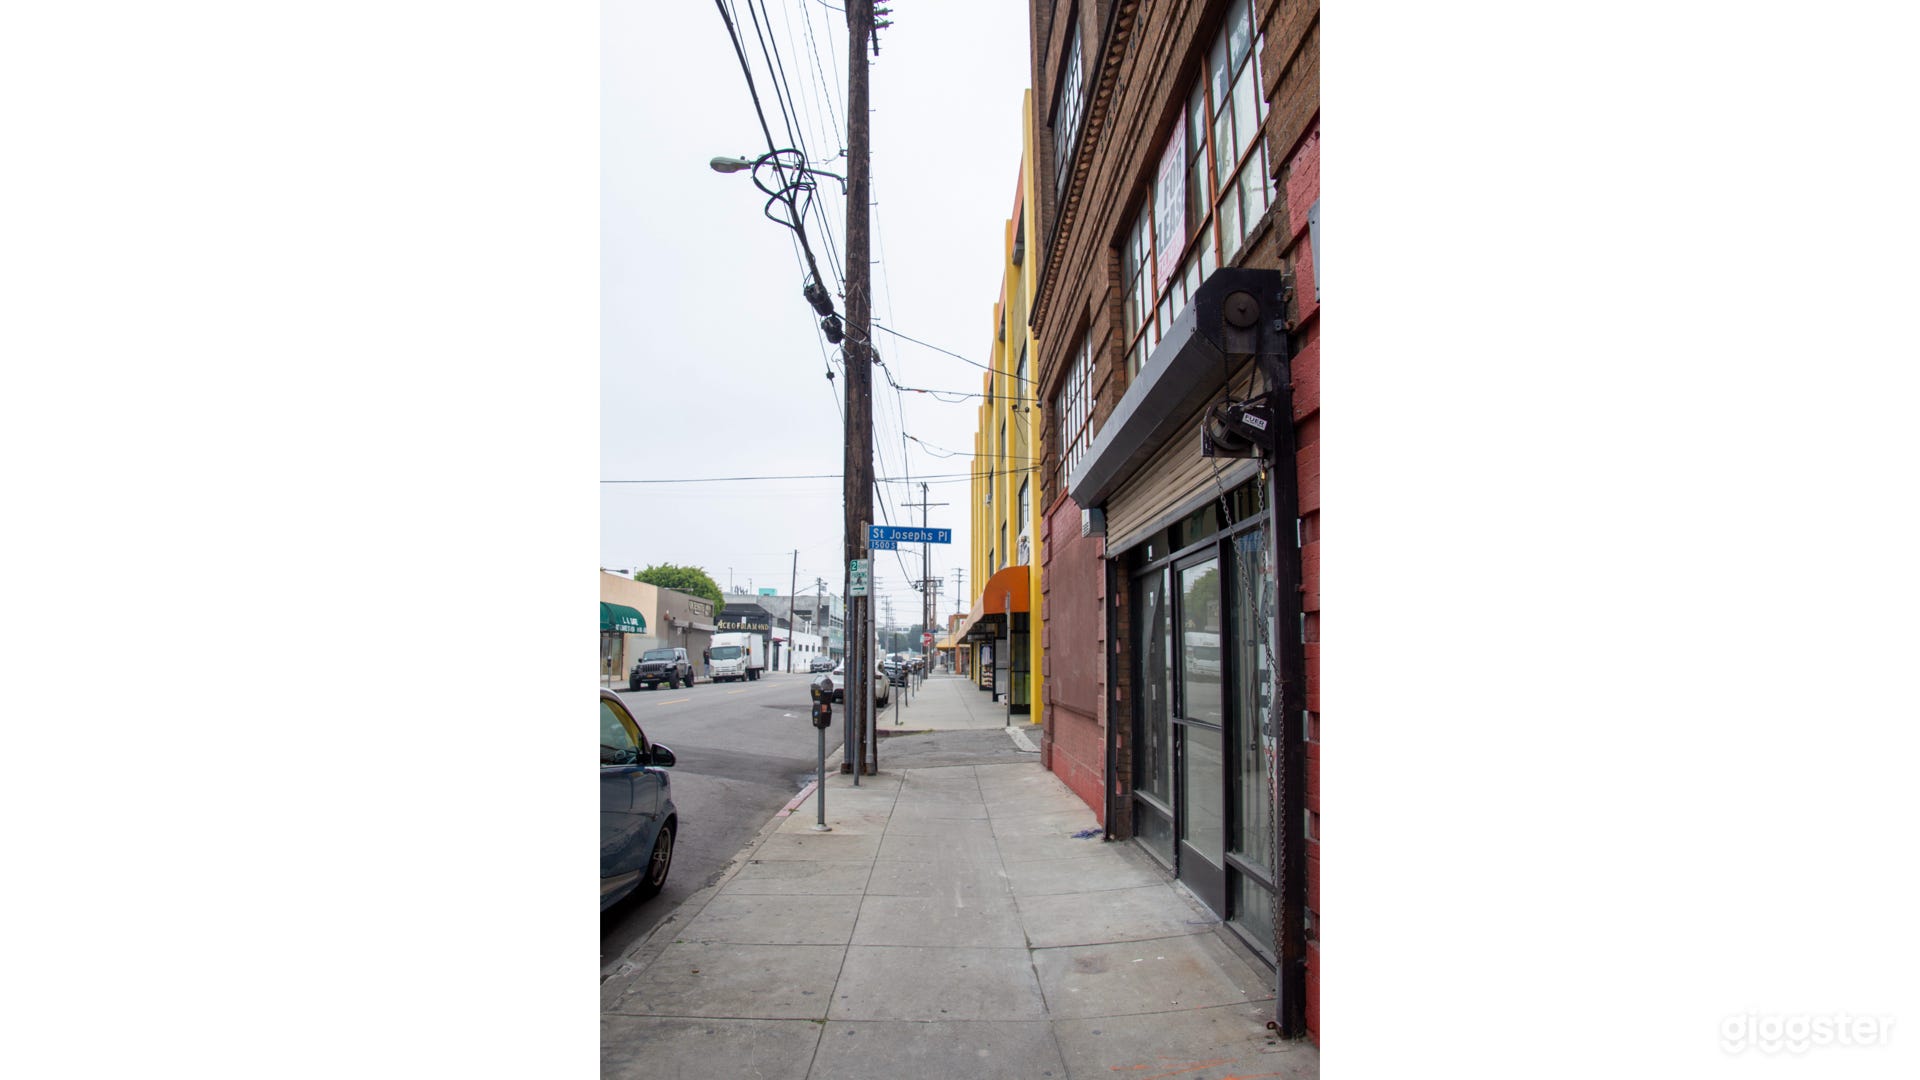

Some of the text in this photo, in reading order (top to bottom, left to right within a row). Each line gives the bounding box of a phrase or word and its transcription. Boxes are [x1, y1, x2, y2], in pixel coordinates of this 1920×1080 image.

[1164, 147, 1182, 211] FOR
[872, 528, 948, 542] St Josephs Pl
[871, 541, 890, 549] 1500
[851, 560, 857, 569] 2
[717, 619, 730, 629] ACE
[731, 622, 740, 630] OF
